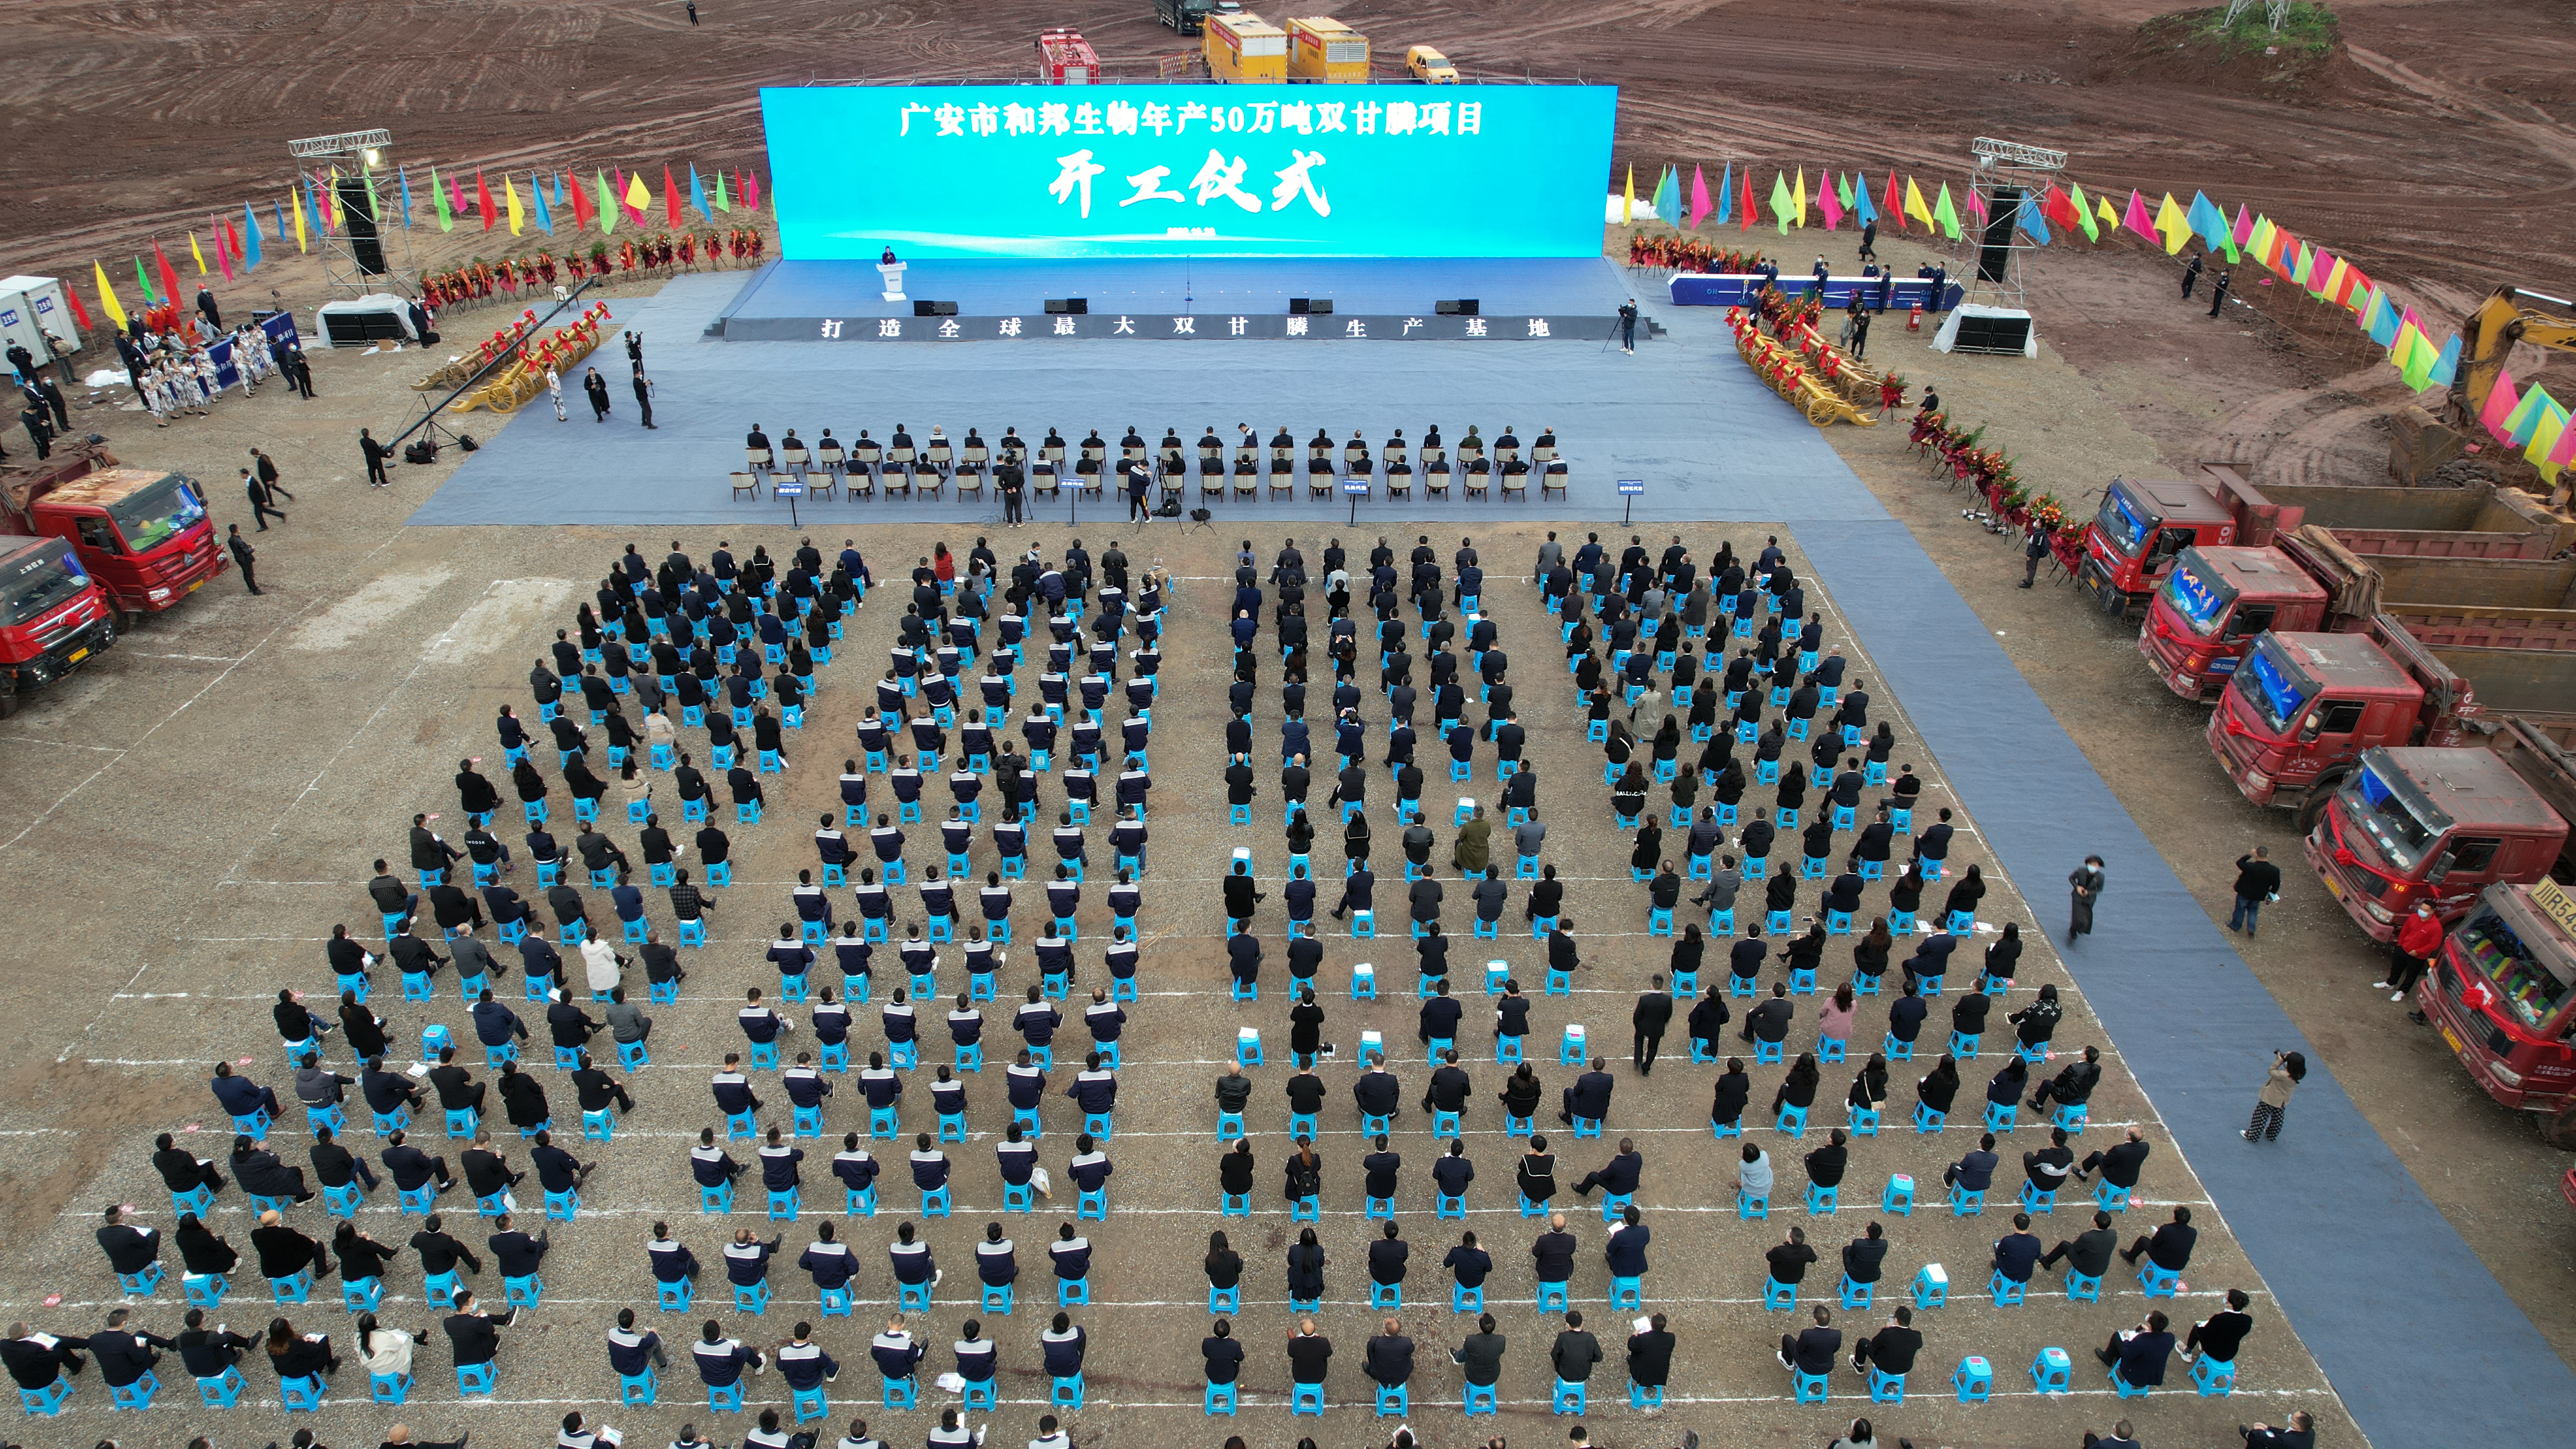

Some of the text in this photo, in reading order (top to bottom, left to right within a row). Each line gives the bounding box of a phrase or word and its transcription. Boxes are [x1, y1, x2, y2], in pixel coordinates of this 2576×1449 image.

[901, 100, 1481, 137] 广安市和邦生物年产50万吨双甘膦项目
[1048, 149, 1330, 218] 开工仪式
[821, 316, 1550, 338] 打造全球最大双甘膦生产基地
[2393, 883, 2405, 892] 18
